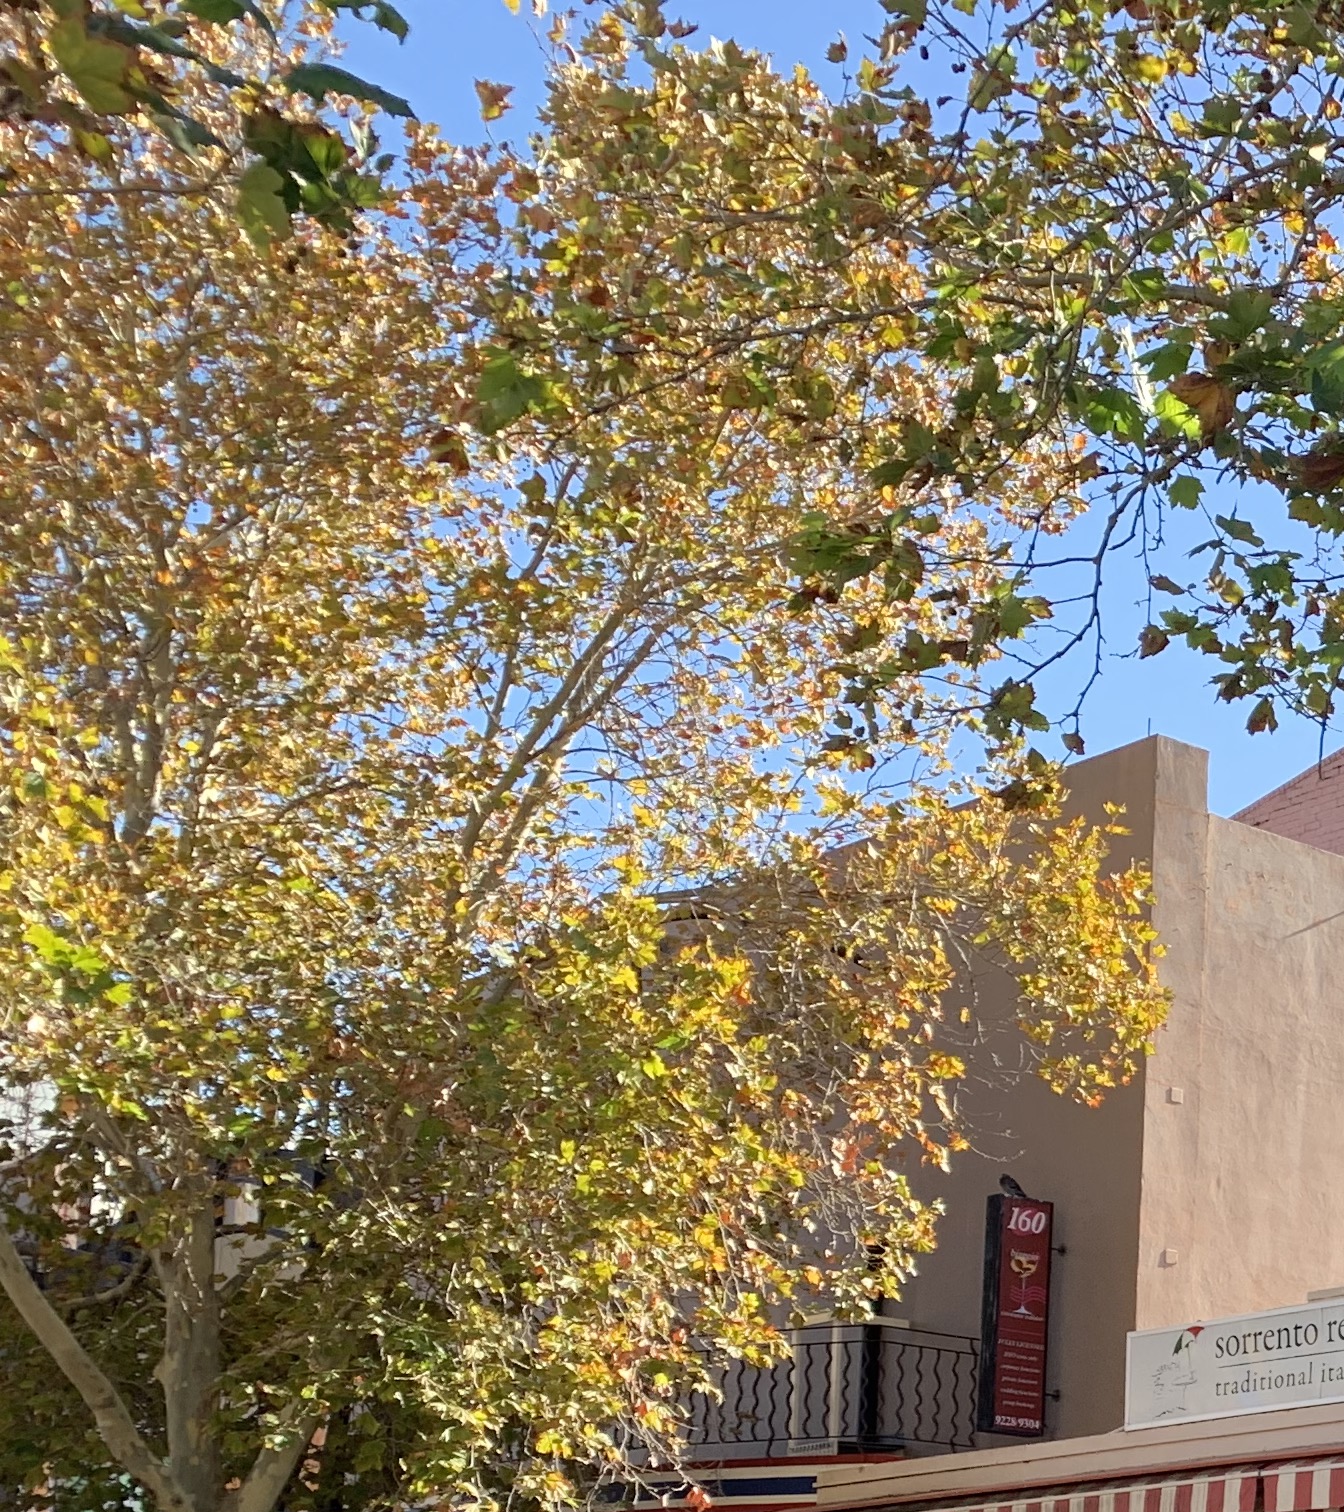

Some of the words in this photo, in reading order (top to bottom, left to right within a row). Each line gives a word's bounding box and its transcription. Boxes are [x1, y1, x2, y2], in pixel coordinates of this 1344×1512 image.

[1007, 1207, 1046, 1234] 160
[1215, 1323, 1318, 1359] sorrento
[1216, 1361, 1312, 1396] traditional
